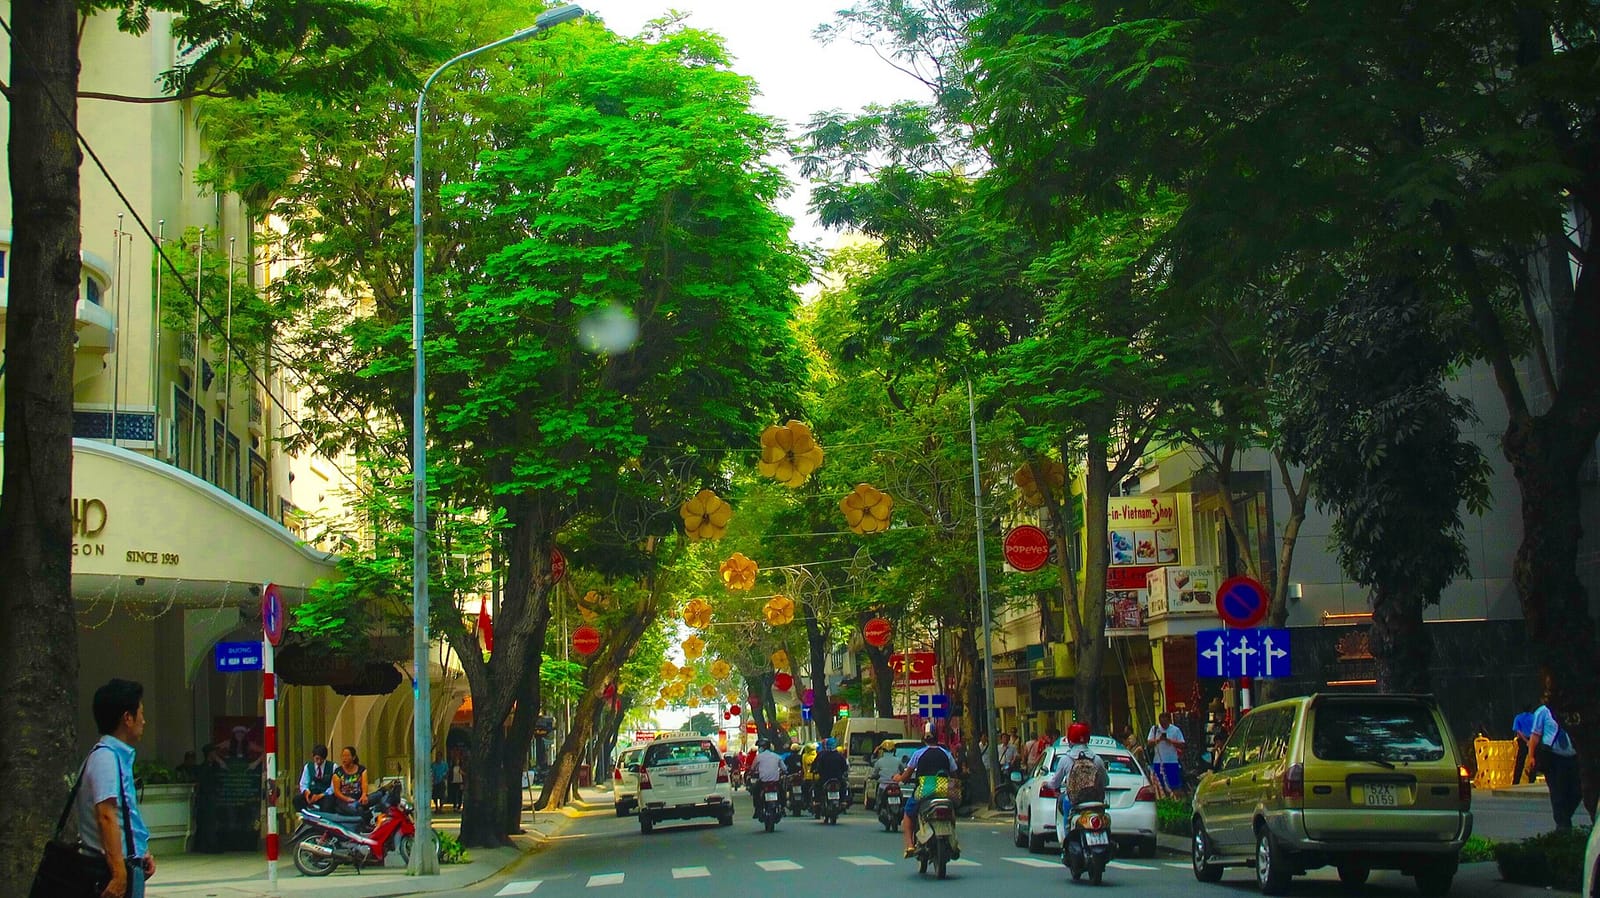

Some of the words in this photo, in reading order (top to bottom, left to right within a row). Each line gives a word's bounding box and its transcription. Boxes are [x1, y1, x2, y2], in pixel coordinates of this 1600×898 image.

[126, 550, 158, 564] SINCE
[161, 552, 180, 565] 1930
[1368, 795, 1394, 805] 0159
